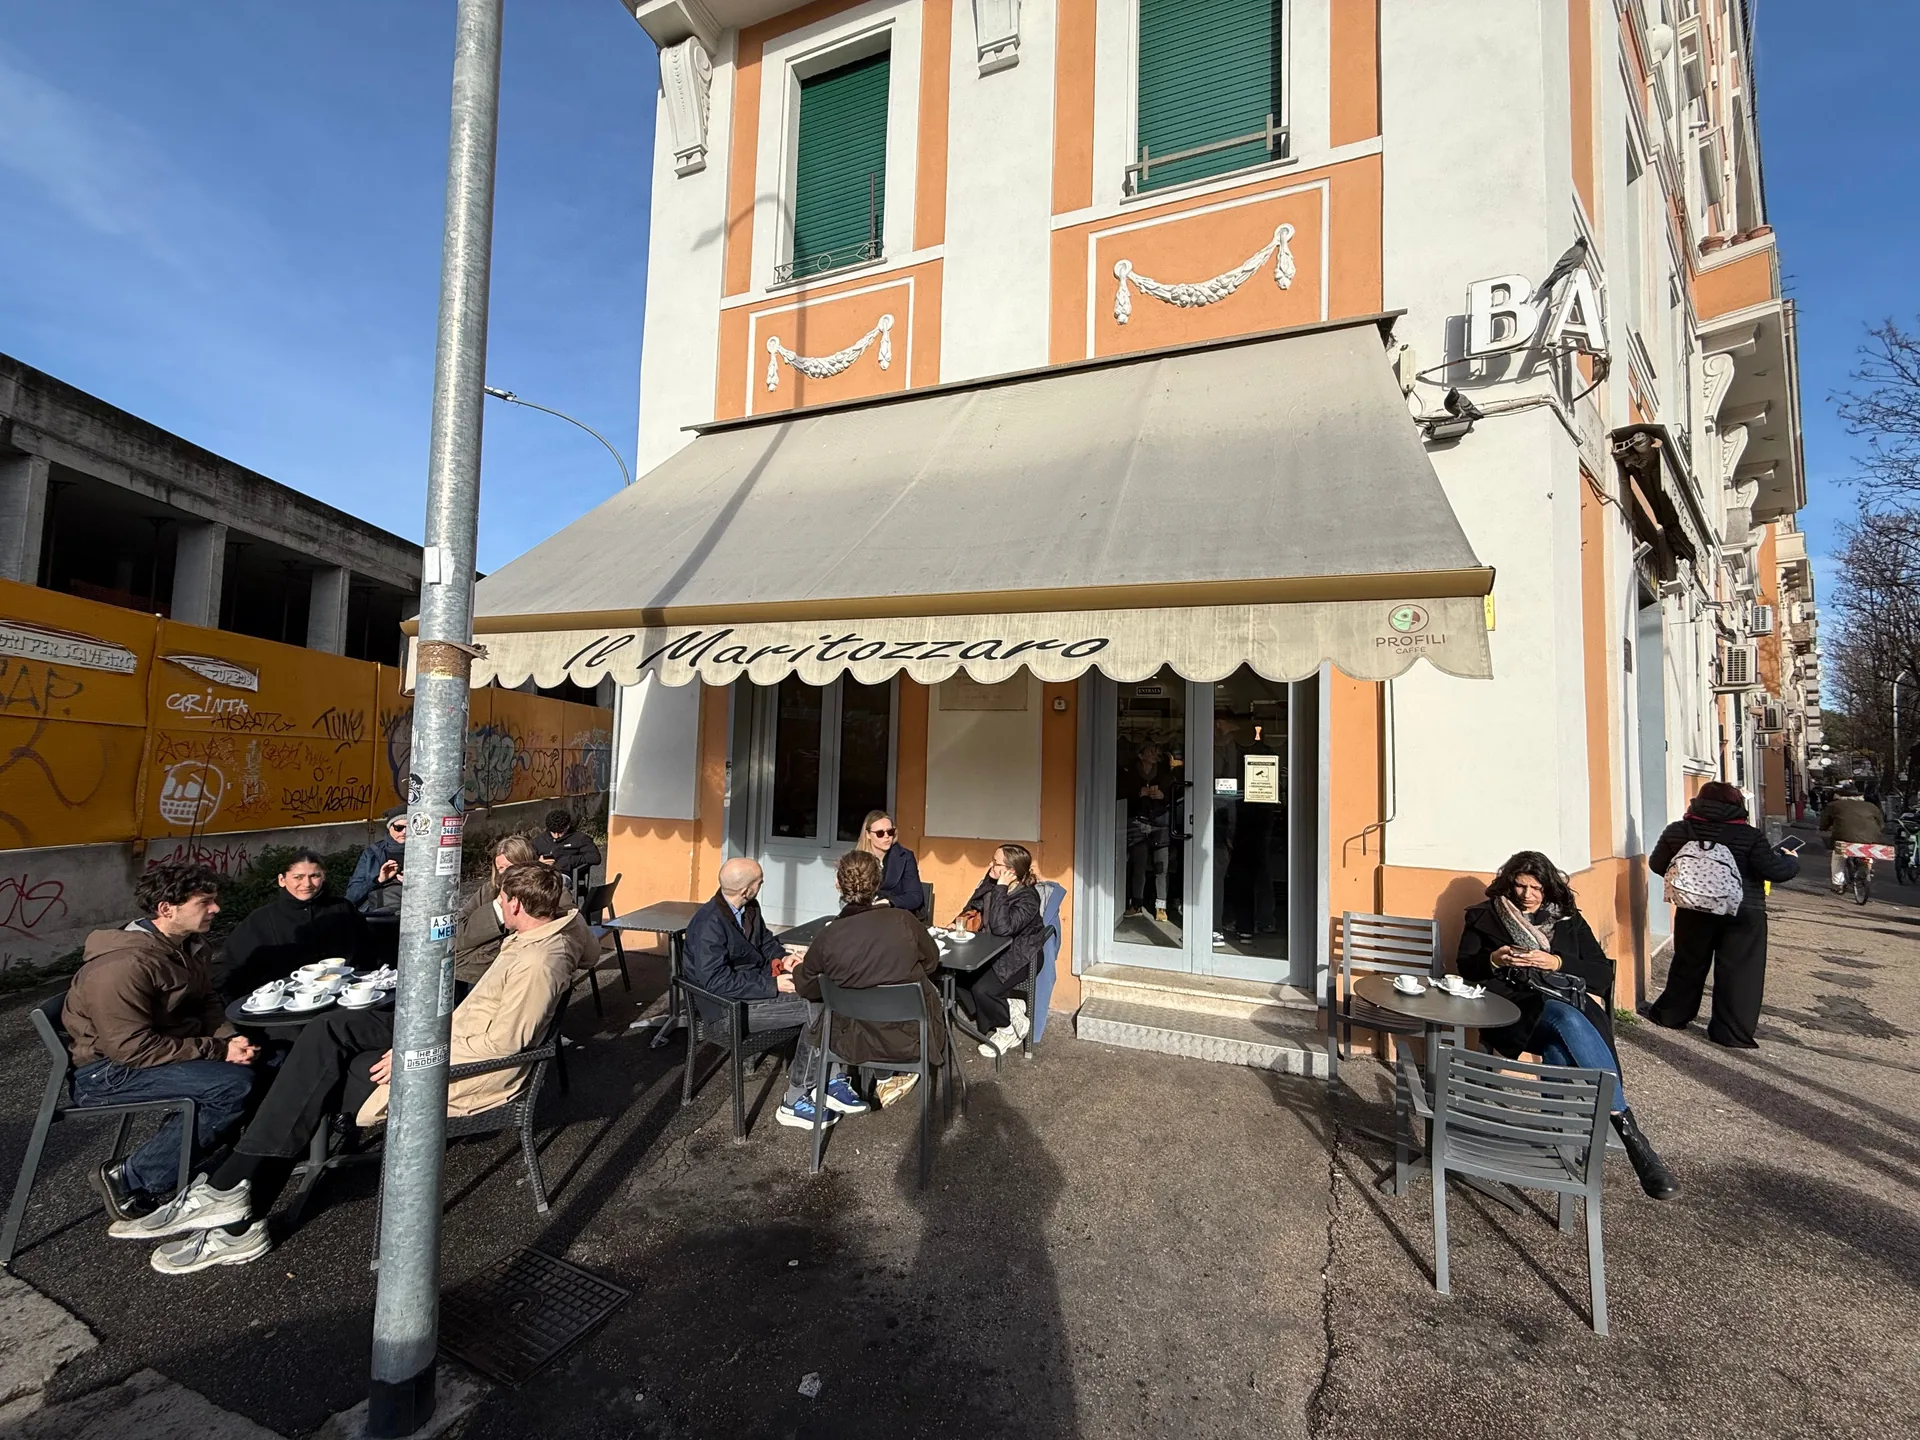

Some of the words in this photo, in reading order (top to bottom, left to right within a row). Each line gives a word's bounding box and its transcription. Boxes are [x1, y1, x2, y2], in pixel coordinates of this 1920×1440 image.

[562, 634, 636, 670] Il
[636, 628, 1110, 670] Maritozzaro
[1375, 633, 1446, 648] PROFILI
